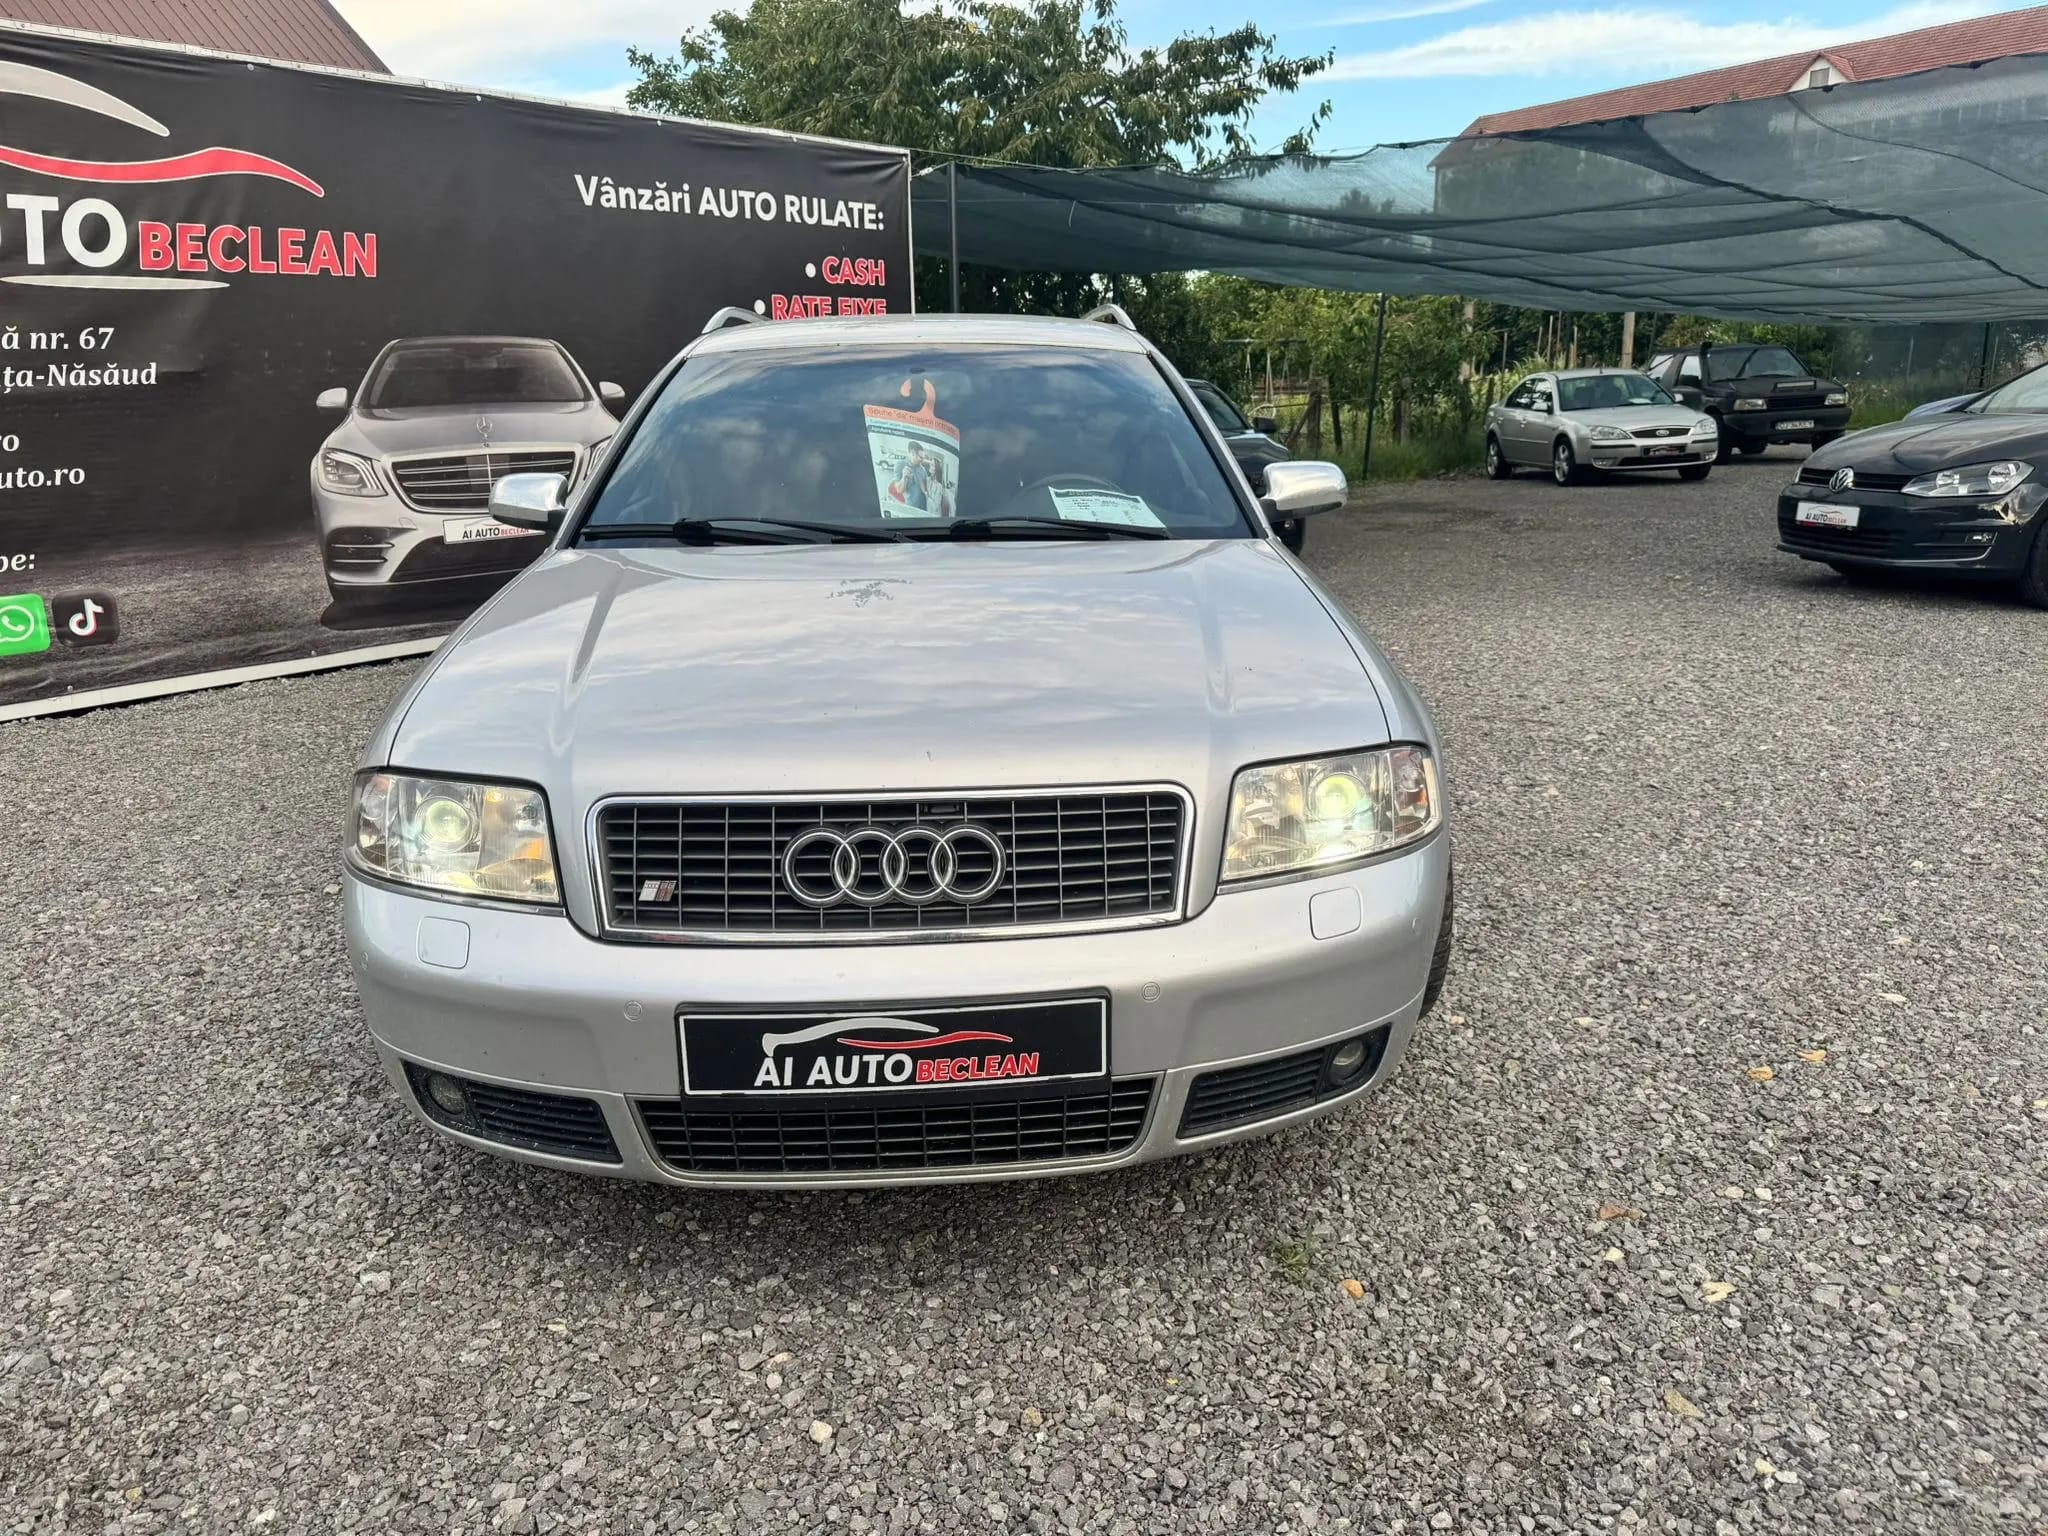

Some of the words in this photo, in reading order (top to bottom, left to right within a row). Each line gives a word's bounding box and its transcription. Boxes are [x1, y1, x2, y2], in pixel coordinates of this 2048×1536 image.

[574, 174, 691, 214] Vânzări
[698, 186, 777, 221] AUTO
[784, 194, 885, 231] RULATE:
[0, 193, 128, 268] TO
[138, 221, 377, 278] BECLEAN
[822, 256, 885, 286] CASH
[771, 294, 832, 320] RATE
[29, 332, 69, 350] nr.
[78, 327, 115, 350] 67
[0, 362, 157, 394] ța-Năsăud
[0, 434, 20, 452] o
[1812, 513, 1828, 522] AUTO
[462, 530, 472, 540] AI
[475, 527, 500, 538] AUTO
[754, 1055, 793, 1087] AI
[806, 1053, 913, 1086] AUTO
[915, 1052, 1040, 1083] BECLEAN
